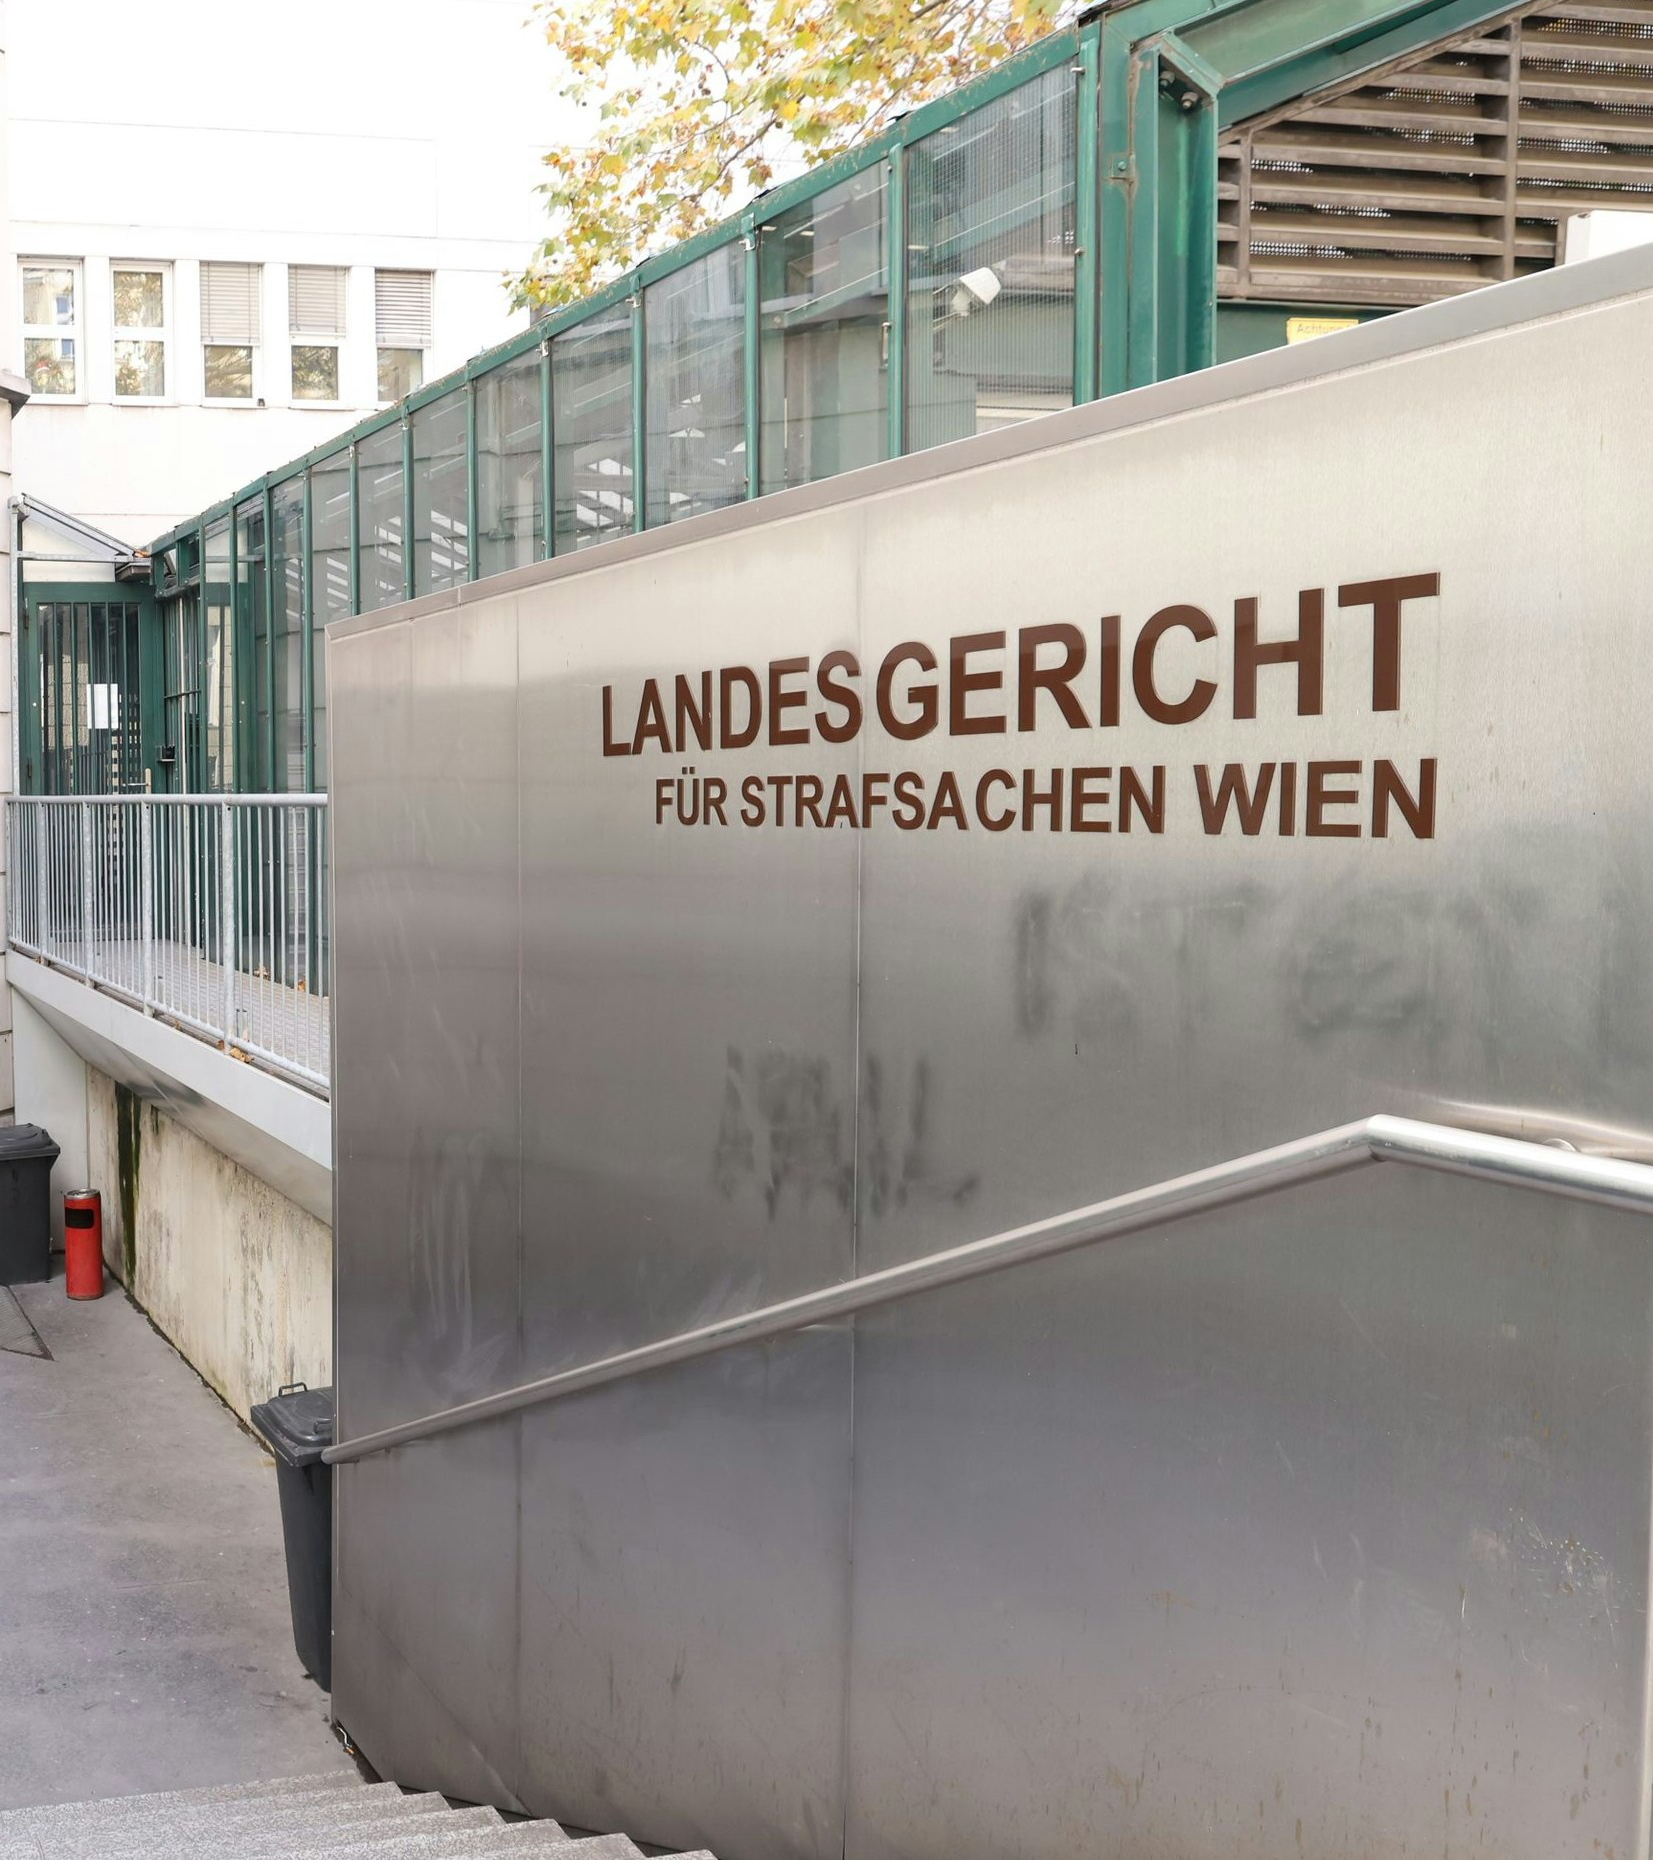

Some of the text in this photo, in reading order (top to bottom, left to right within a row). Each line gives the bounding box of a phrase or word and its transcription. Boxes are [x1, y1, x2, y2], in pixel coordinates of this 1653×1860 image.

[602, 571, 1441, 757] LANDESGERICHT
[655, 757, 1437, 839] FÜR STRAFSACHEN WIEN
